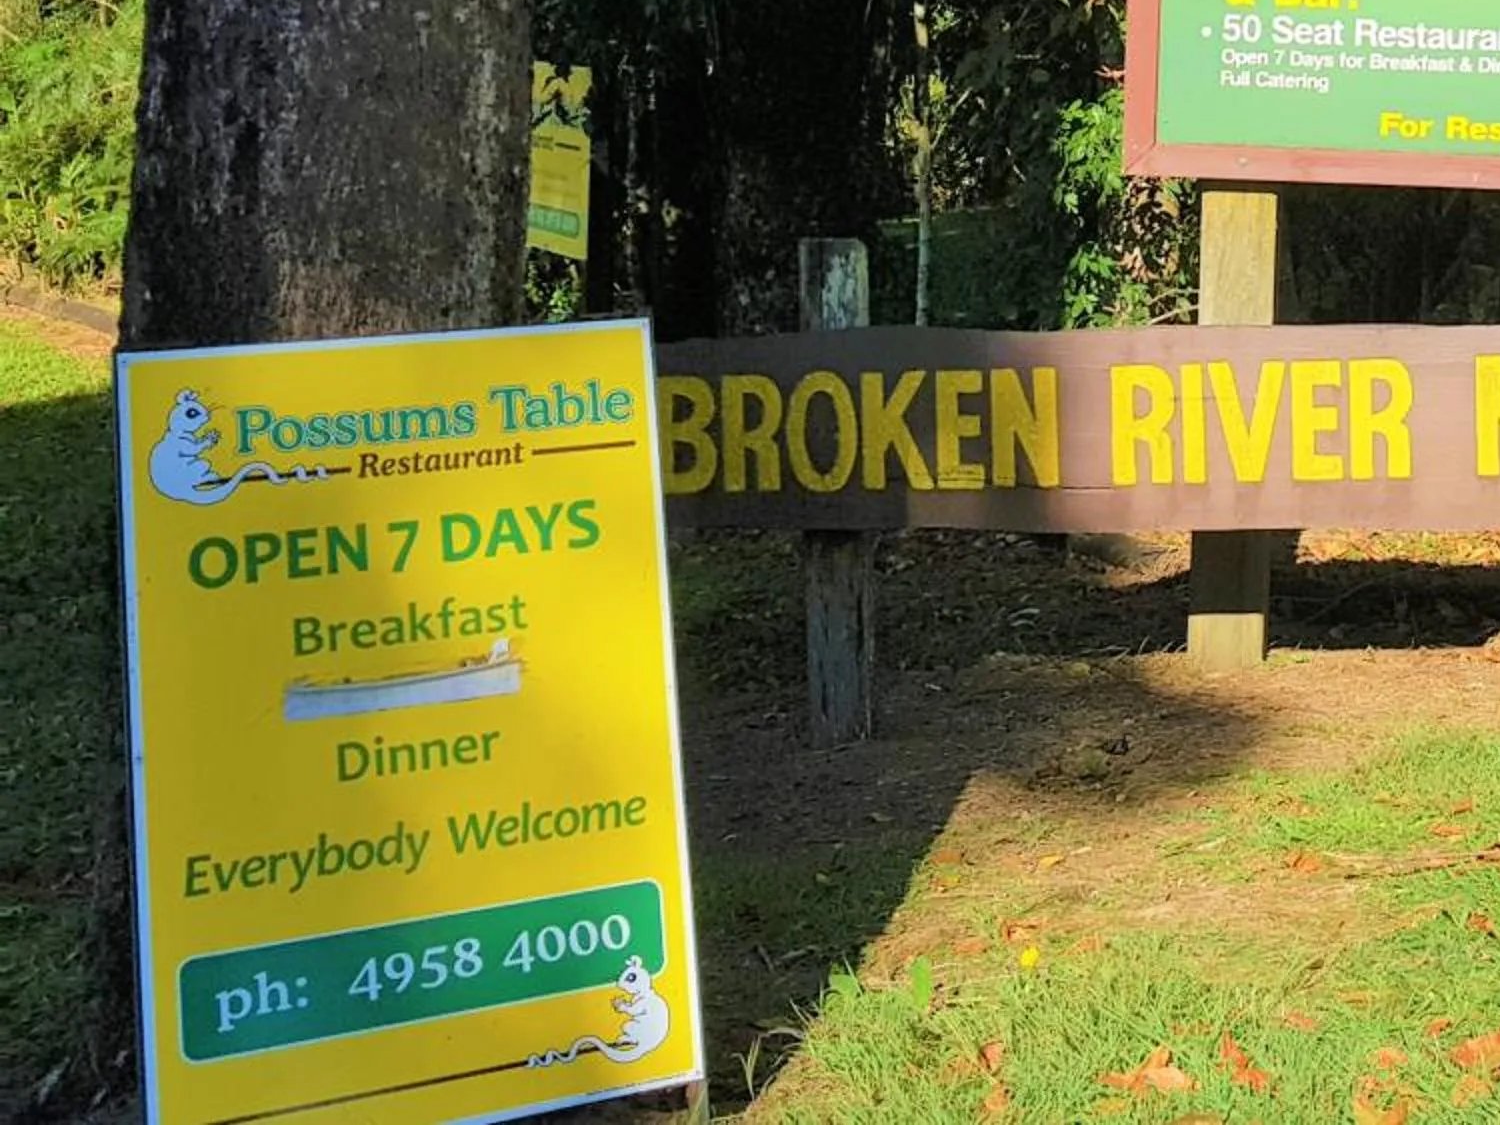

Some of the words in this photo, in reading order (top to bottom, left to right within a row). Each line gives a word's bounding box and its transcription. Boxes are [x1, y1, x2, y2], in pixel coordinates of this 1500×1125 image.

[1222, 14, 1262, 43] 50
[1271, 16, 1344, 46] Seat
[1220, 71, 1251, 87] Full
[1255, 71, 1330, 93] Catering
[1221, 48, 1268, 67] Open
[1275, 51, 1284, 65] 7
[1290, 50, 1334, 70] Days
[1339, 52, 1363, 68] for
[1369, 53, 1455, 72] Breakfast
[1459, 56, 1473, 72] &
[1380, 112, 1434, 138] For
[235, 398, 478, 454] Possums
[489, 379, 635, 432] Table
[659, 367, 1060, 493] BROKEN
[1110, 359, 1414, 486] RIVER
[357, 442, 525, 478] Restaurant
[188, 522, 368, 590] OPEN
[387, 519, 422, 573] 7
[440, 499, 600, 564] DAYS
[293, 595, 528, 657] Breakfast
[336, 729, 501, 782] Dinner
[183, 821, 430, 898] Everybody
[447, 794, 646, 855] Welcome
[215, 970, 308, 1033] ph:
[348, 937, 484, 1002] 4958
[502, 913, 632, 973] 4000
